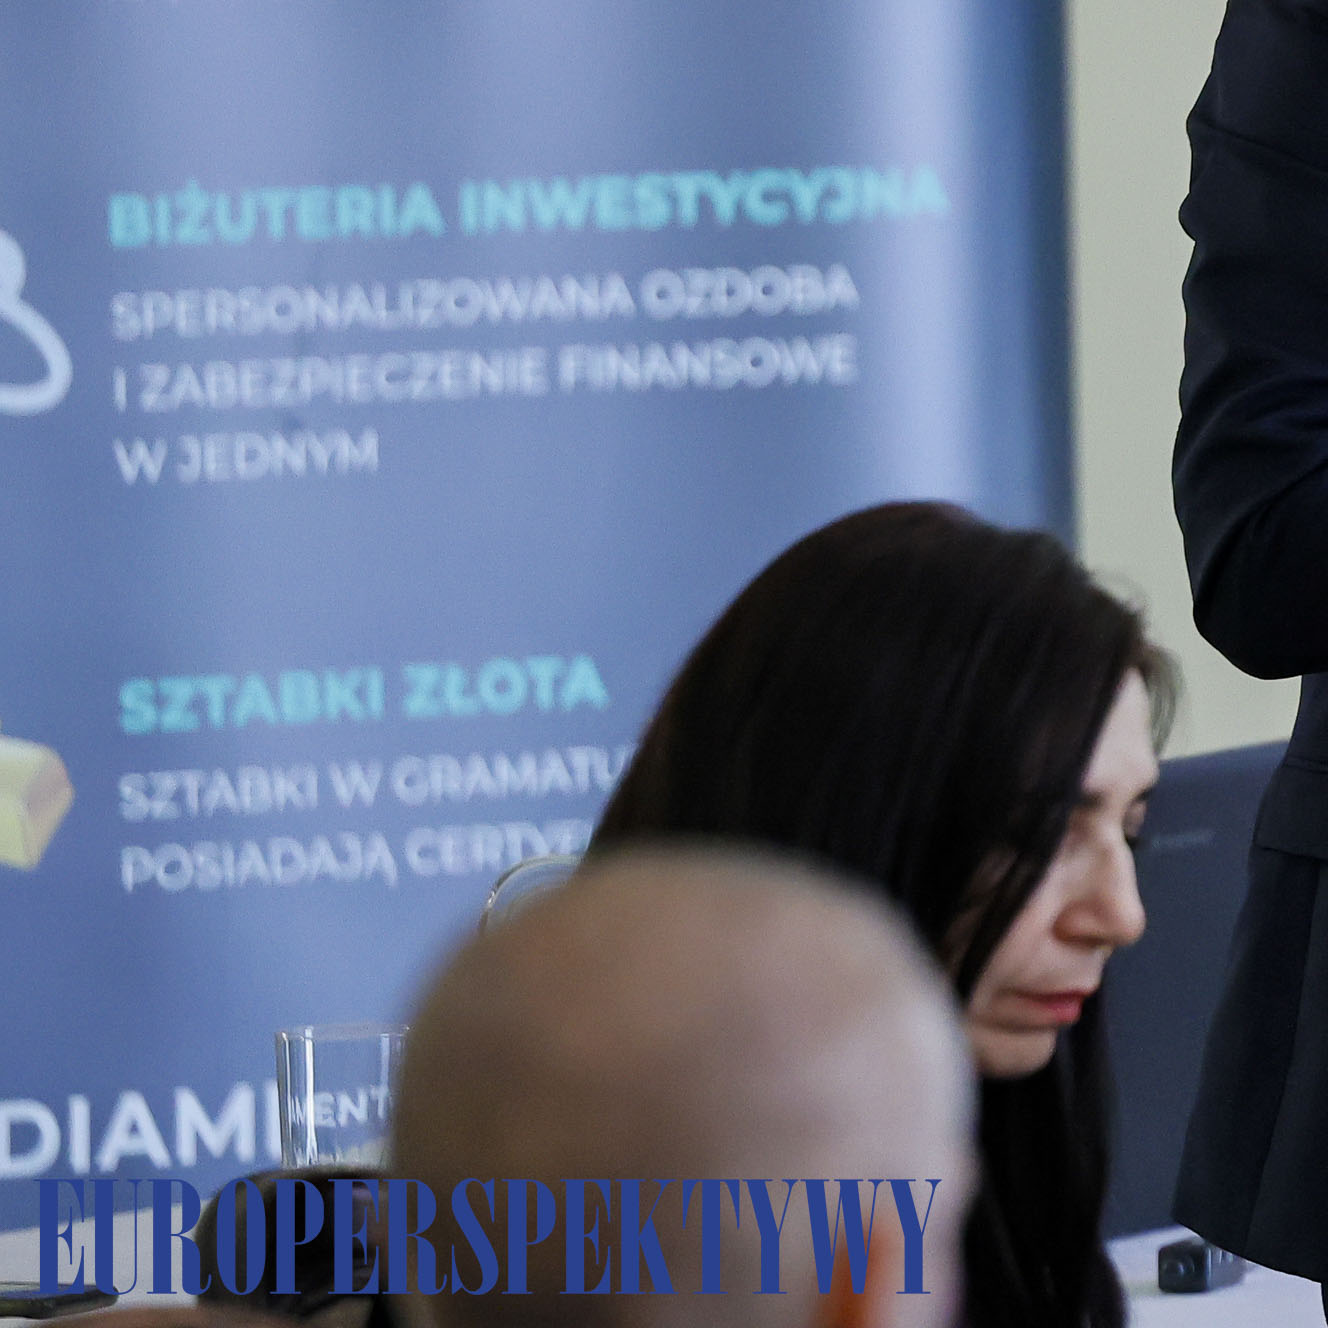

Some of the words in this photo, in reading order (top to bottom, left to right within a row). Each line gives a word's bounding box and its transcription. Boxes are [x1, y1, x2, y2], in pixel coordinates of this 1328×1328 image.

[108, 176, 448, 248] BIŻUTERIA
[460, 165, 950, 233] INWESTYCYJNA
[110, 272, 637, 342] SPERSONALIZOWANA
[641, 263, 861, 320] OZDOBA
[113, 365, 127, 413] I
[140, 344, 550, 414] ZABEZPIECZENIE
[559, 332, 860, 392] FINANSOWE
[113, 436, 168, 486] W
[176, 426, 380, 484] JEDNYM
[119, 666, 386, 736] SZTABKI
[118, 762, 322, 822] SZTABKI
[328, 759, 384, 809] W
